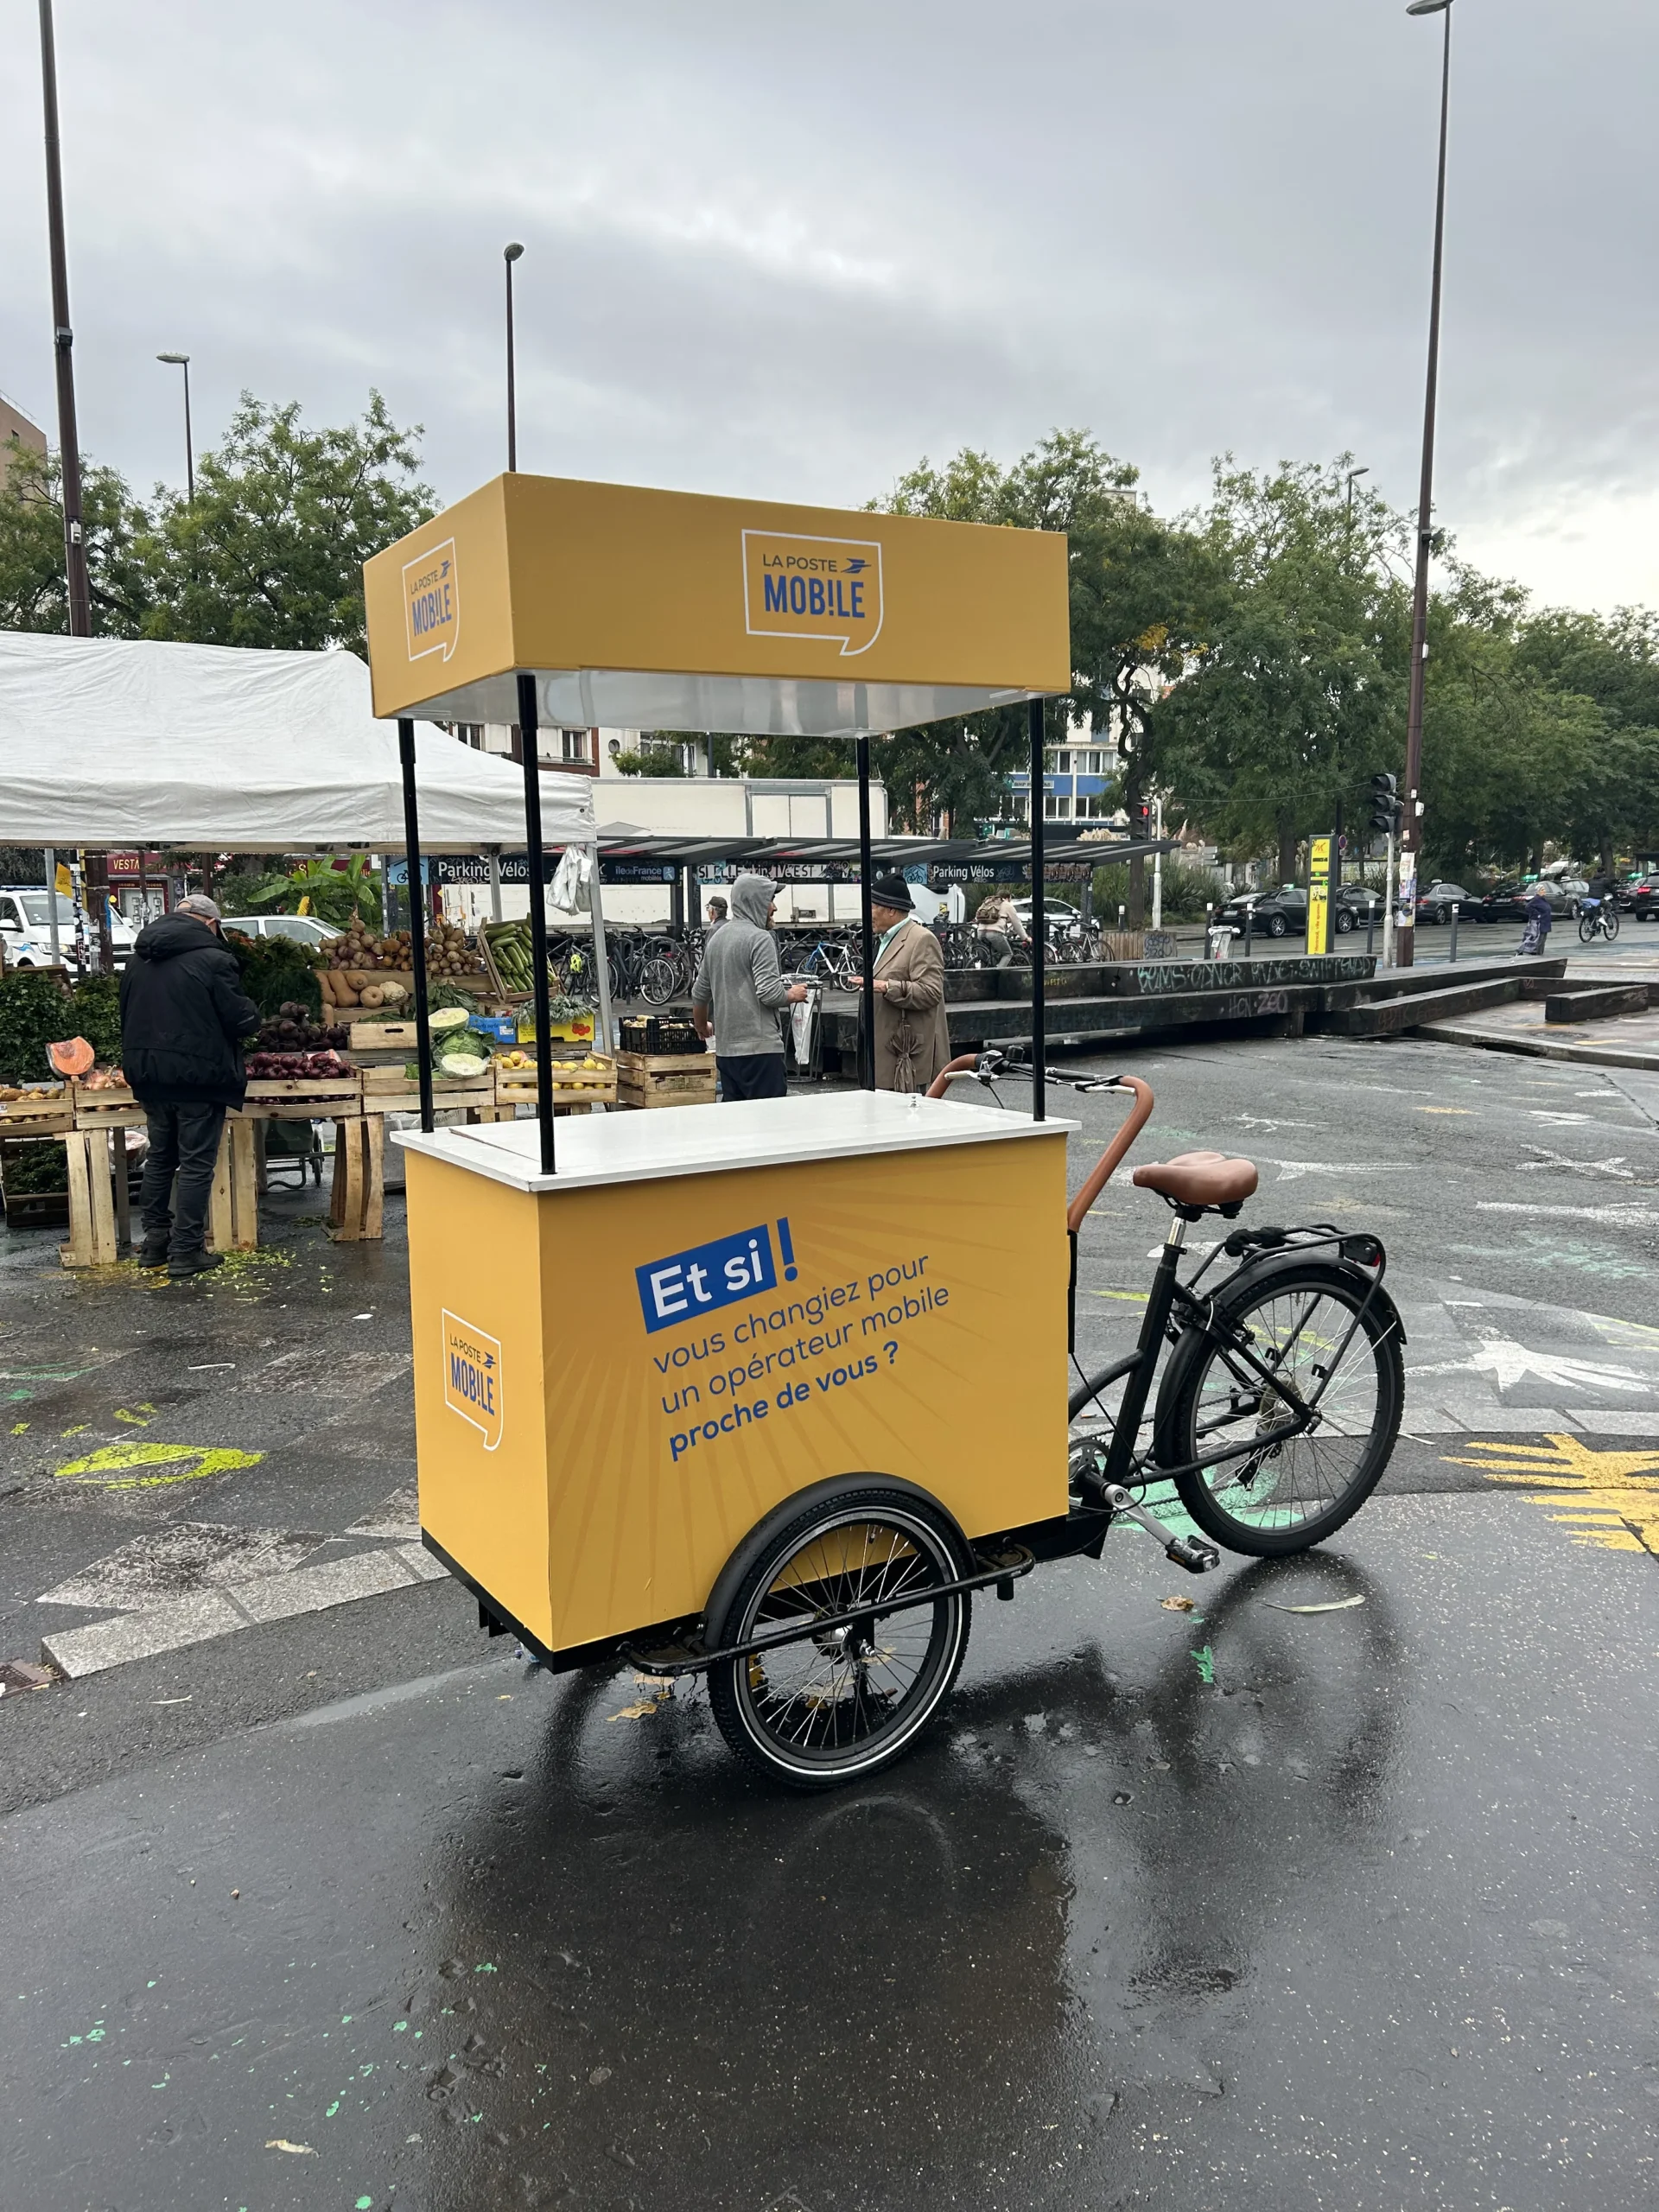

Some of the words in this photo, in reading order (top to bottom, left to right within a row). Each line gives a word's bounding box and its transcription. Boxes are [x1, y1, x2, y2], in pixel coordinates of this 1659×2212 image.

[763, 554, 784, 568] LA
[787, 556, 837, 572] POSTE
[410, 580, 419, 594] LA
[419, 569, 439, 590] POSTE
[438, 861, 490, 880] Parking
[933, 866, 967, 880] Parking
[969, 865, 994, 877] Vélos
[650, 1263, 714, 1318] Et
[724, 1239, 764, 1291] si
[777, 1217, 798, 1281] !
[653, 1332, 726, 1374] vous
[734, 1281, 860, 1343] changiez
[868, 1255, 929, 1300] pour
[450, 1333, 458, 1350] LA
[459, 1340, 481, 1363] POSTE
[662, 1384, 700, 1414] un
[709, 1322, 853, 1396] opérateur
[861, 1287, 950, 1336] mobile
[669, 1399, 768, 1462] proche
[777, 1382, 810, 1409] de
[816, 1355, 878, 1392] vous
[883, 1340, 899, 1364] ?
